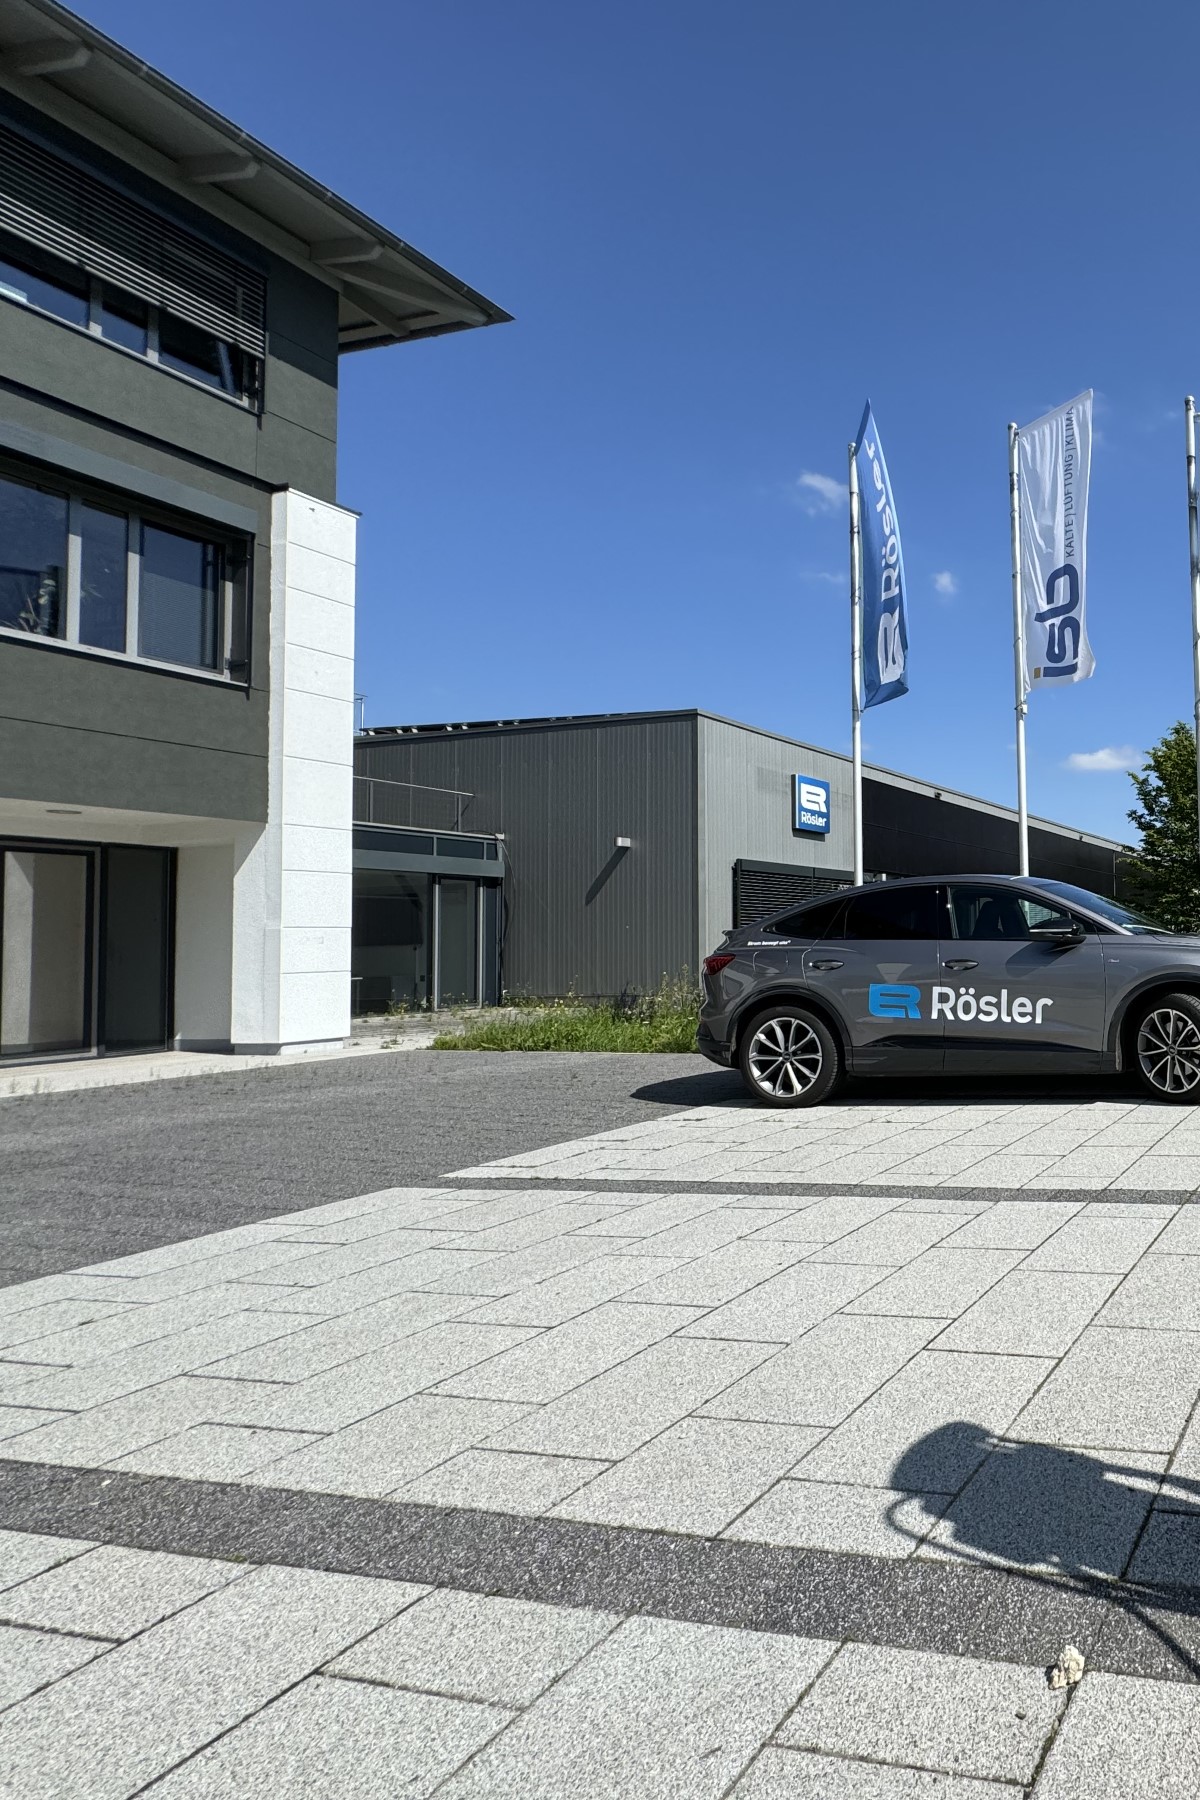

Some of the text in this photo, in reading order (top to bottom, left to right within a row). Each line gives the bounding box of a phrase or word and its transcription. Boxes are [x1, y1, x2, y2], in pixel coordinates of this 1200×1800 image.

[1064, 406, 1075, 449] KLIMA
[864, 438, 900, 600] Rösler
[1033, 563, 1081, 679] isb
[801, 811, 827, 827] Rösler
[931, 986, 1054, 1024] Rösler
